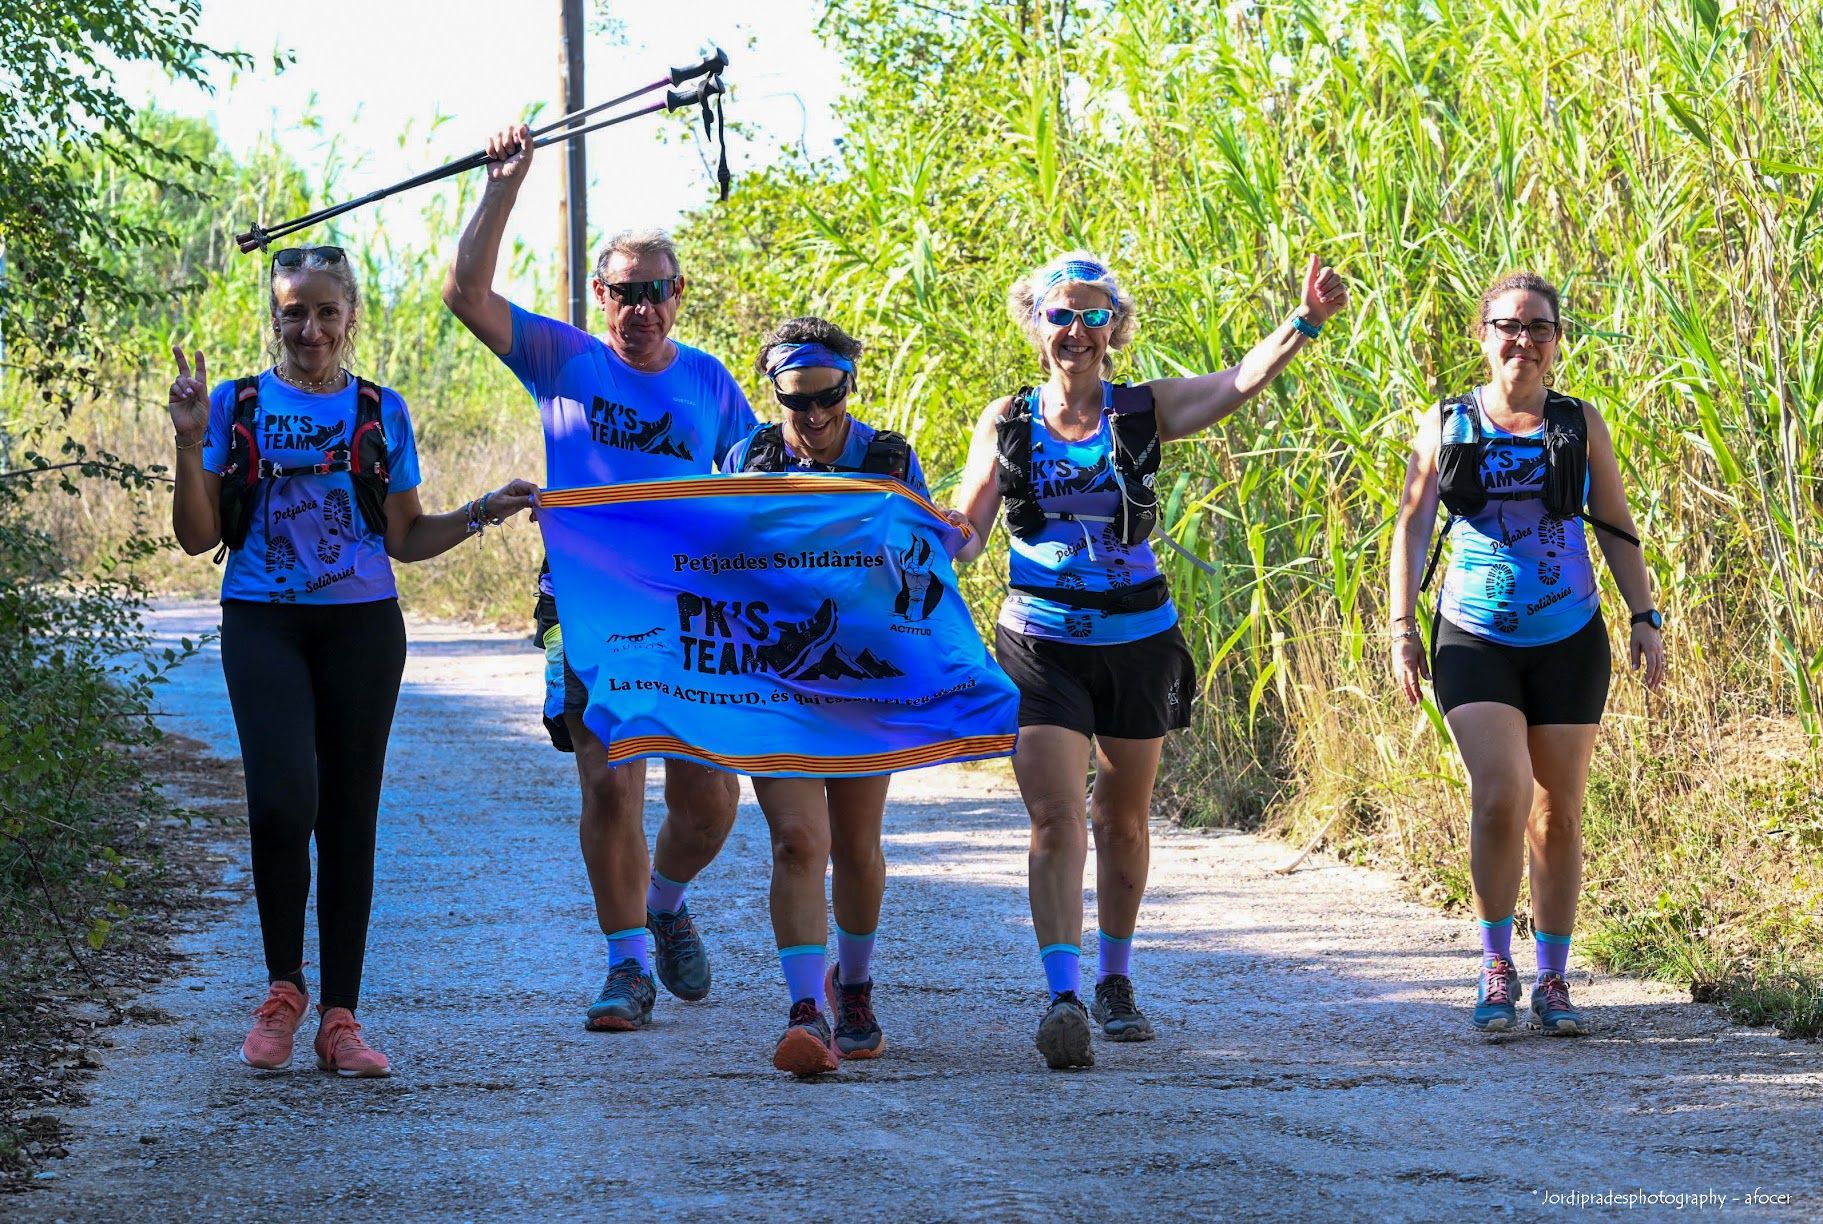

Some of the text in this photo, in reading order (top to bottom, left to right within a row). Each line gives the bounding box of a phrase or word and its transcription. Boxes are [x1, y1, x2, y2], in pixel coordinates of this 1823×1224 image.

[264, 414, 313, 434] PK'S
[591, 395, 639, 431] PK'S
[263, 433, 312, 450] TEAM
[590, 420, 635, 451] TEAM
[1031, 459, 1072, 479] K'S
[1480, 450, 1514, 469] K'S
[1031, 479, 1074, 499] EAM
[1484, 470, 1513, 488] AM
[272, 499, 318, 525] Petjades
[1055, 534, 1098, 563] Petjads
[672, 549, 884, 575] Petjades Solidàries
[304, 565, 356, 594] Solidàries
[1526, 586, 1573, 616] Solidàries
[676, 592, 770, 641] PK'S
[889, 624, 932, 636] ACTITUD
[679, 635, 768, 676] TEAM
[609, 678, 631, 691] La
[635, 678, 669, 695] teva
[673, 685, 766, 706] ACTITUD,
[770, 689, 789, 702] és
